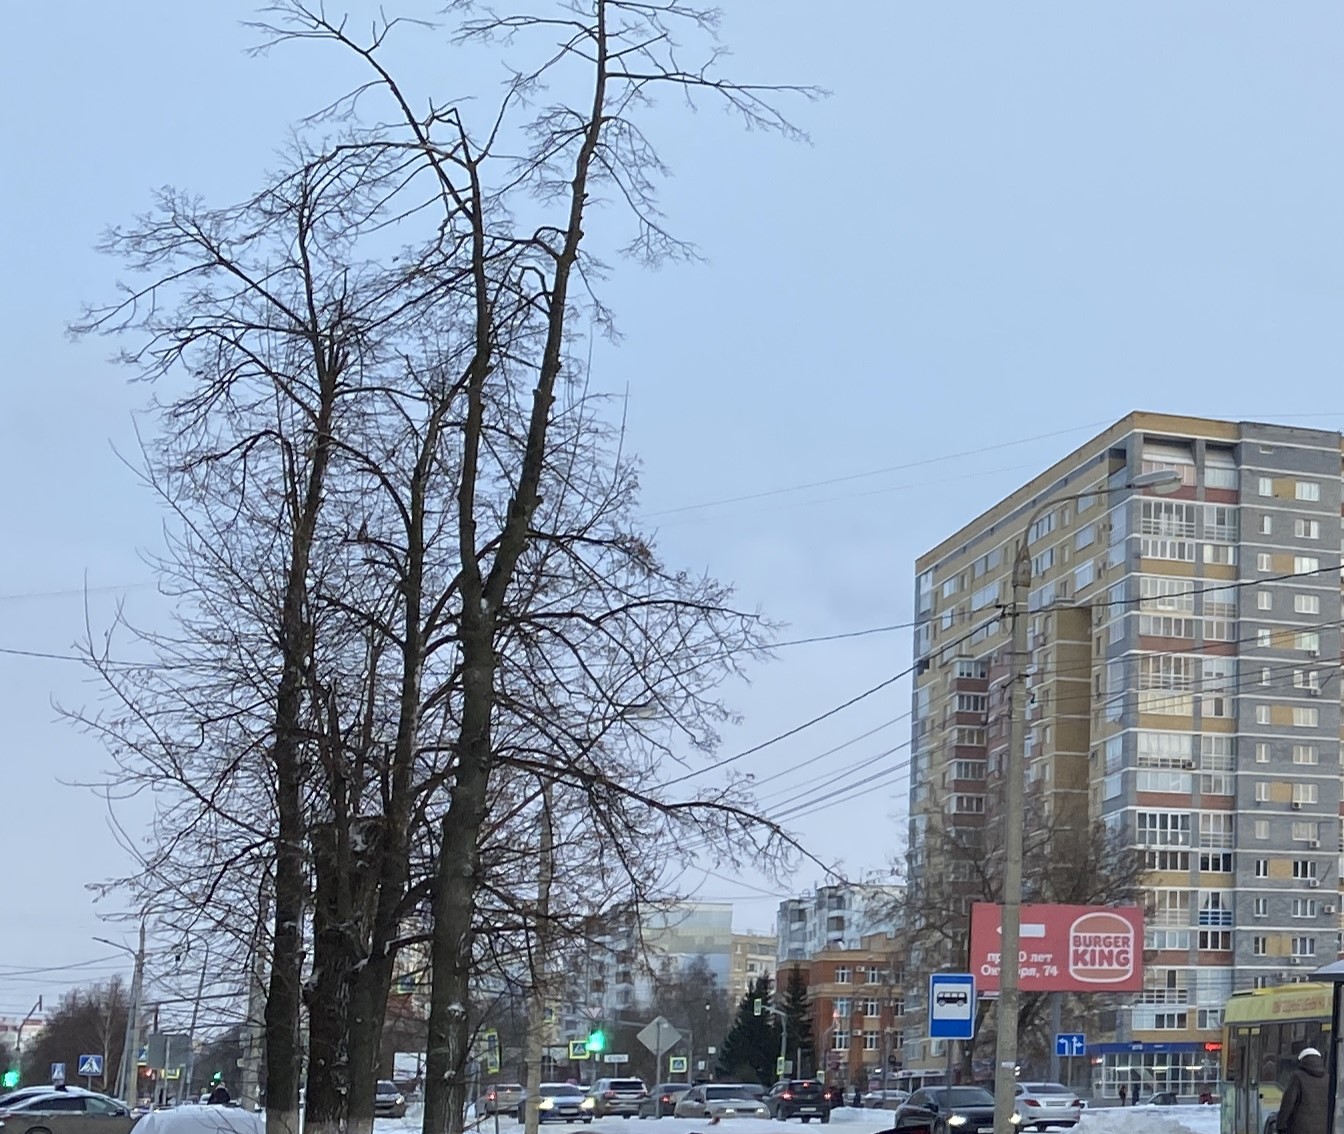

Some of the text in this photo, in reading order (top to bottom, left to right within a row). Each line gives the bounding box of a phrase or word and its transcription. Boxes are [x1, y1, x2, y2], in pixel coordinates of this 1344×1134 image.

[1073, 935, 1130, 948] BURGER
[1030, 954, 1053, 962] лет
[1073, 949, 1130, 967] KING
[1043, 965, 1058, 976] 74
